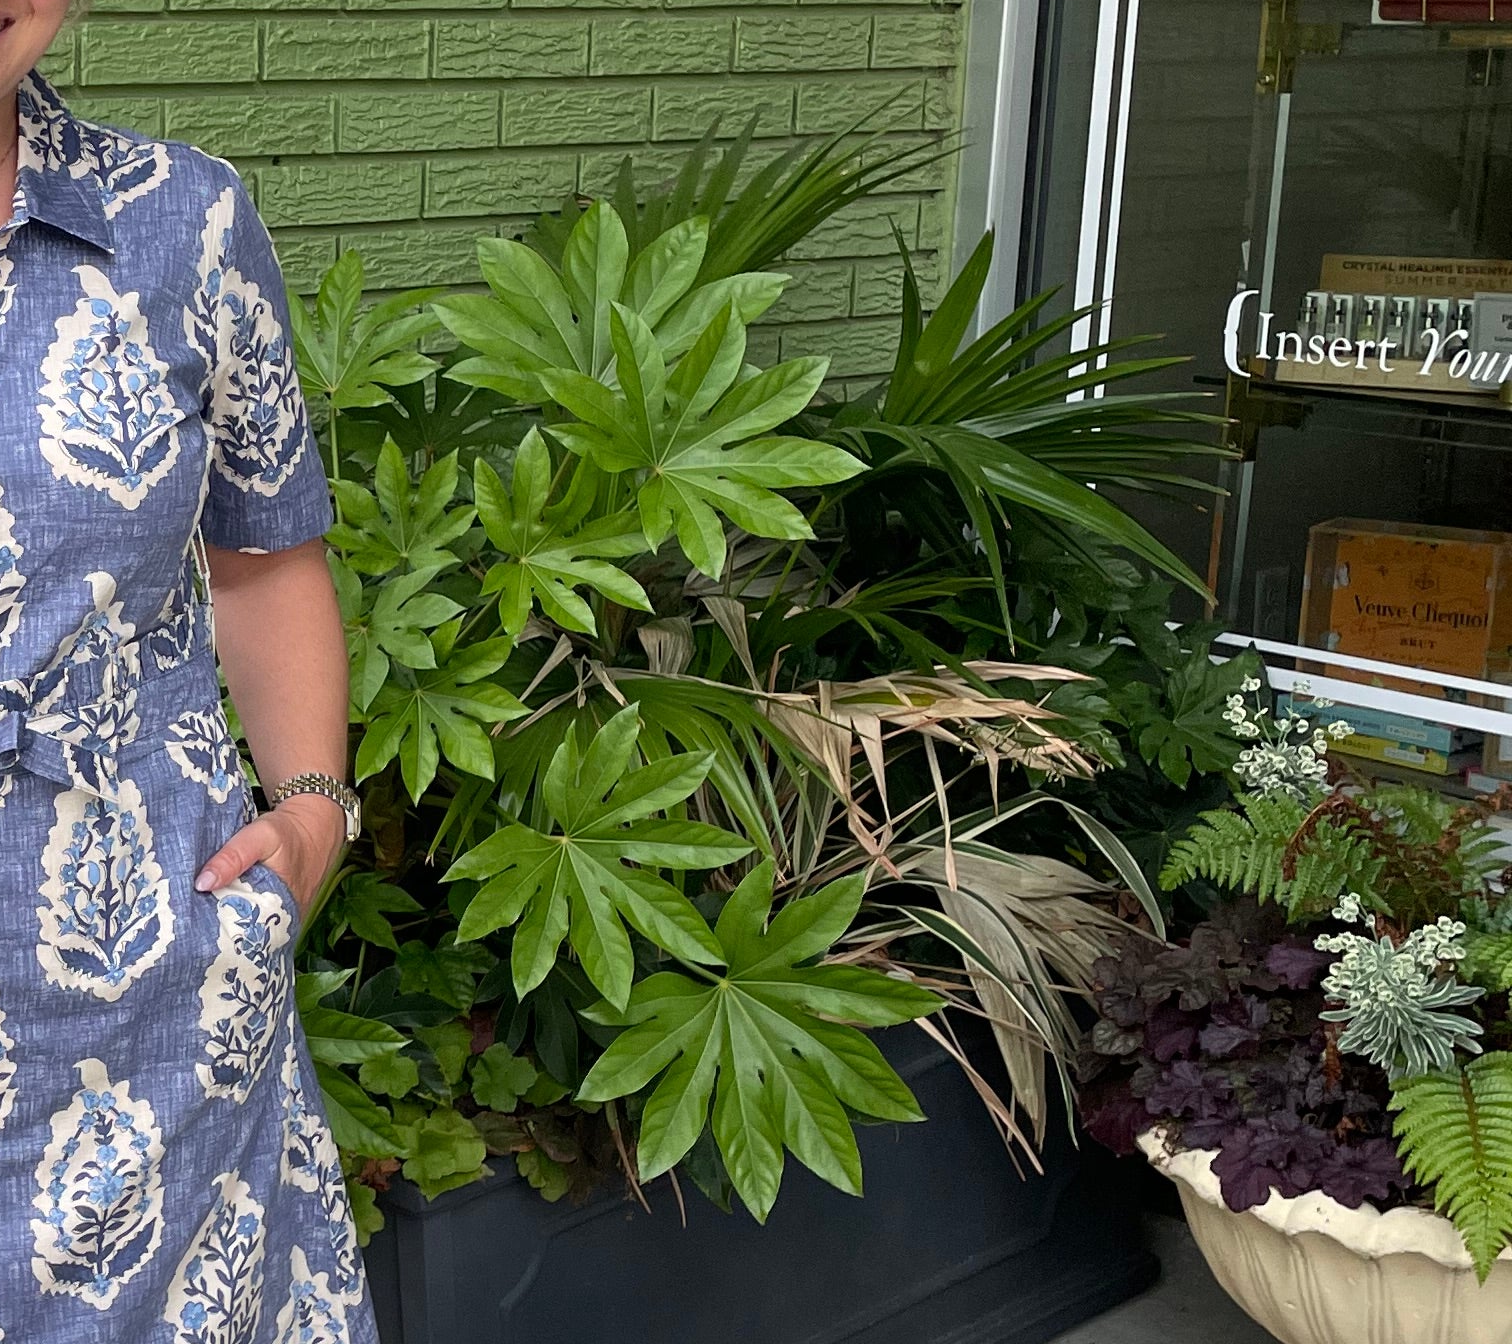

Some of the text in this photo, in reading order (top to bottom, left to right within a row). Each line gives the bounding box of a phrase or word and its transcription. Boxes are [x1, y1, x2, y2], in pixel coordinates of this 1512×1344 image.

[1343, 260, 1395, 272] CRYSTAL
[1399, 263, 1453, 274] HEALING
[1384, 274, 1456, 288] SUMMER
[1355, 594, 1408, 618] Veuve
